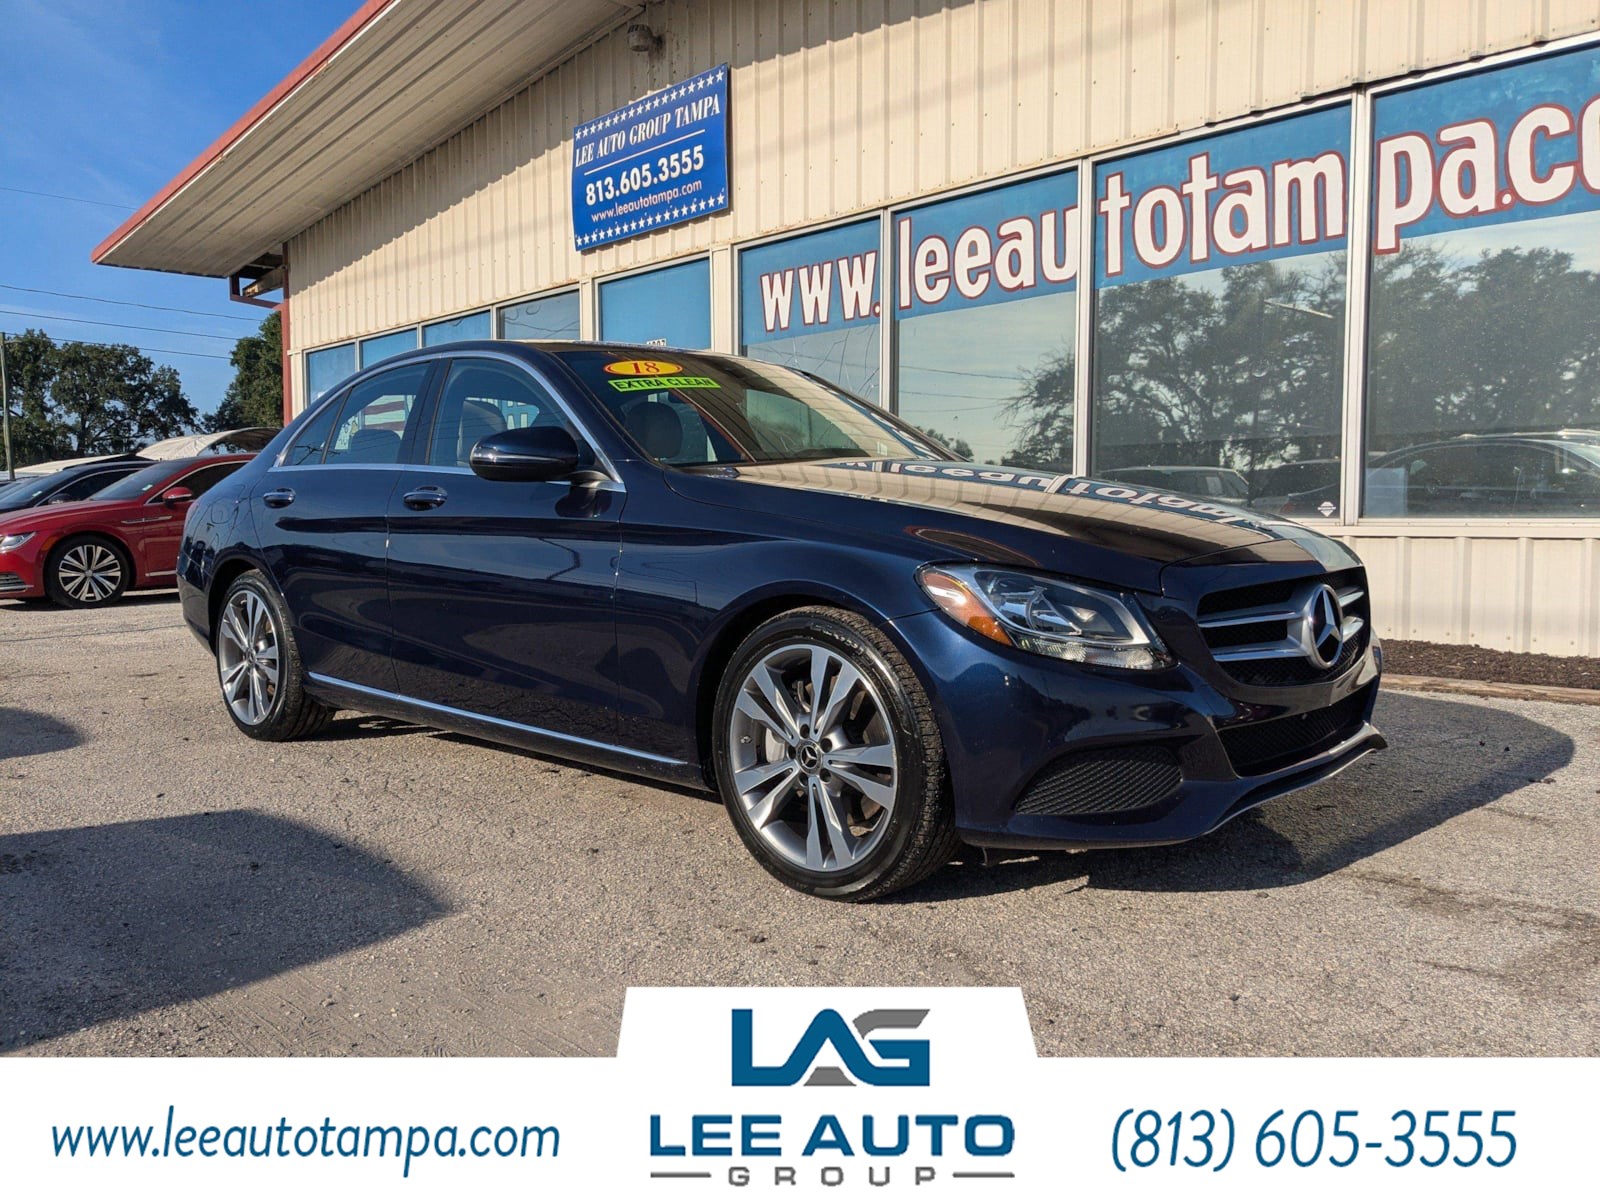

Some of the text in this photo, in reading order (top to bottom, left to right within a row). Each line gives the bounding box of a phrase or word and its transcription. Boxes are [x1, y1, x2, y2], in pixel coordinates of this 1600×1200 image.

[575, 93, 720, 168] LEE AUTO GROUP TAMPA
[586, 144, 705, 206] 813.605.3555
[591, 179, 703, 223] www.leeautotampa.com
[614, 377, 713, 390] EXTRA CLEAN
[632, 362, 660, 374] 18
